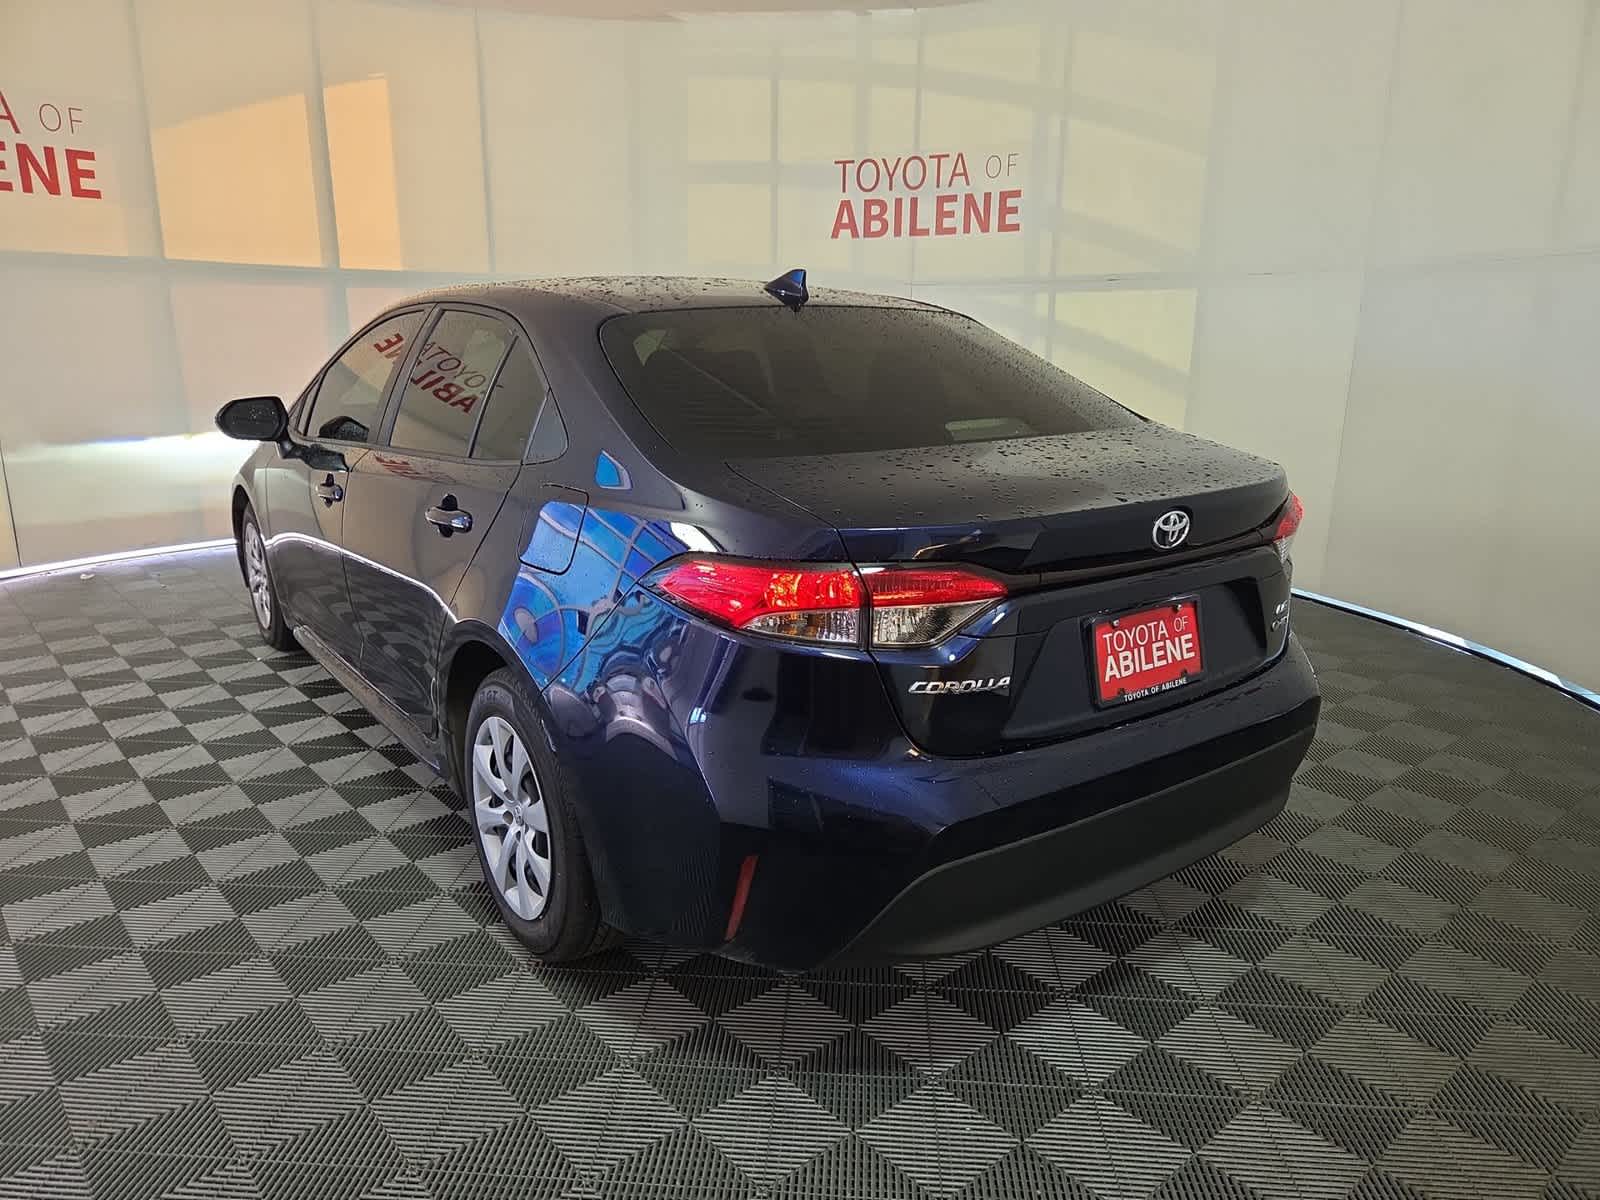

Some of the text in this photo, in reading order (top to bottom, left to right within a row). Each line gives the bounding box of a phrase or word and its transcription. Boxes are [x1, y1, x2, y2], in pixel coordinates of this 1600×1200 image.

[39, 103, 83, 135] OF
[834, 152, 1020, 193] TOYOTA OF
[831, 190, 1022, 239] ABILENE
[1103, 616, 1189, 654] TOYOTA OF
[1105, 634, 1196, 682] ABILENE
[908, 676, 1011, 694] COROLLA
[1124, 677, 1188, 702] TOYOTA OF ABILENE
